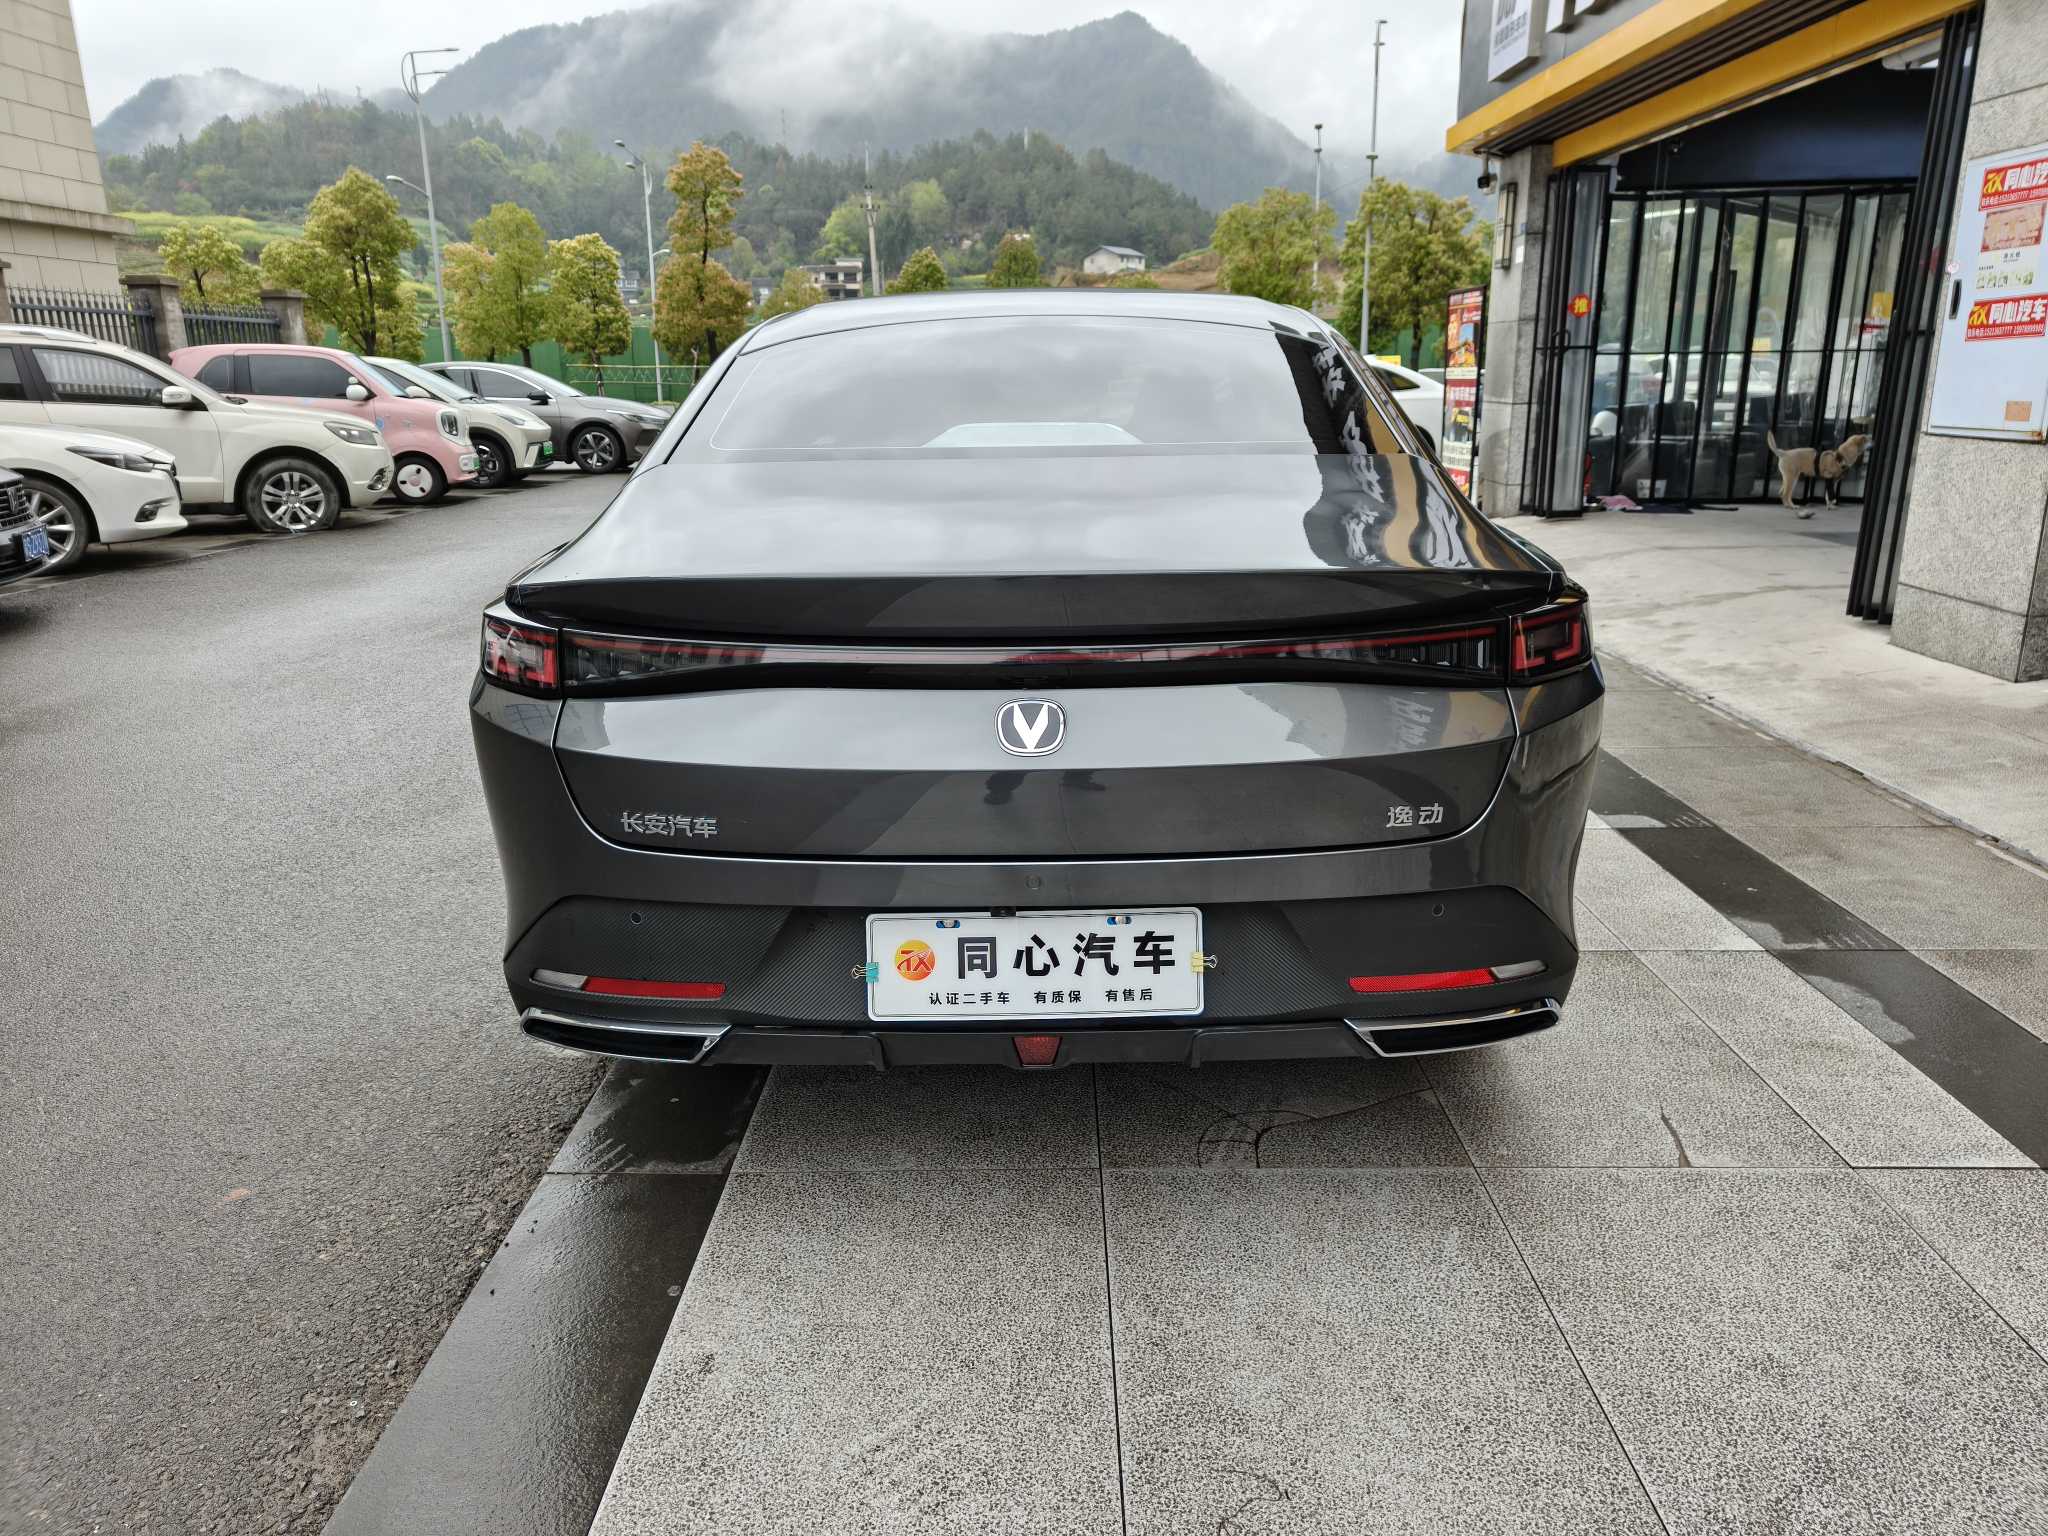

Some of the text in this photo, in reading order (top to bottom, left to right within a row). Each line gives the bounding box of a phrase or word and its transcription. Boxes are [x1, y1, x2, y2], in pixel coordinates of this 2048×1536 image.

[1989, 299, 2048, 324] 同心汽车
[620, 812, 718, 839] 长安汽车
[1386, 803, 1444, 828] 逸动
[957, 930, 1176, 979] 同心汽车
[928, 988, 1154, 1006] 认证二手车 有质保 有售后
